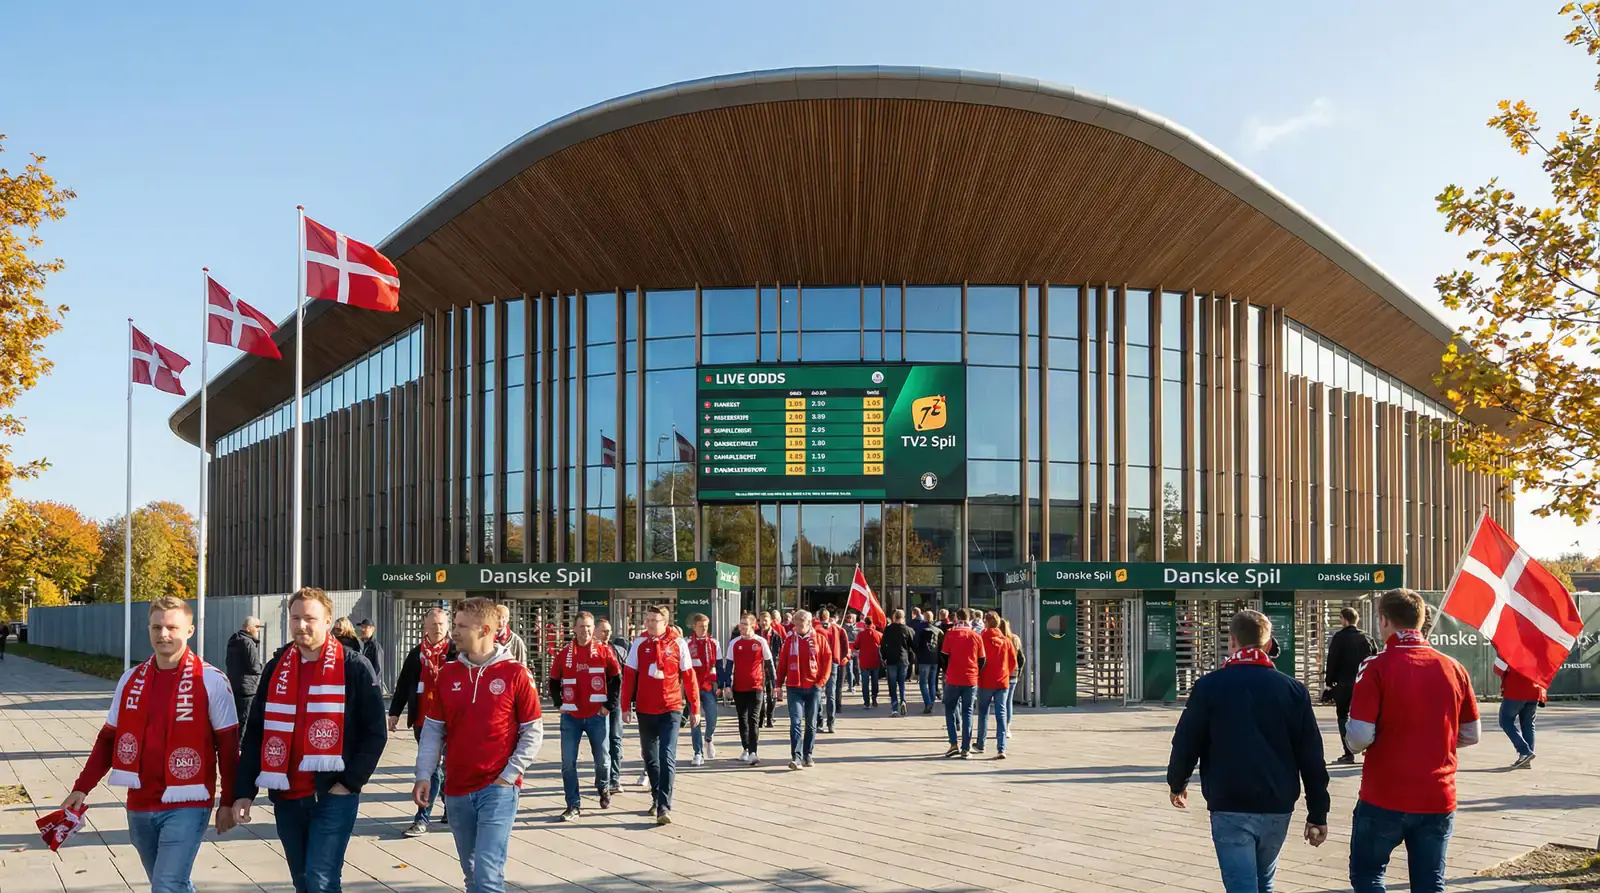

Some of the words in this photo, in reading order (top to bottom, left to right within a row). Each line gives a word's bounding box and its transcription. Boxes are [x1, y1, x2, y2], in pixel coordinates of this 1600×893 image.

[716, 373, 745, 384] LIVE
[748, 372, 786, 384] ODDS
[901, 436, 928, 447] TV2
[931, 435, 956, 450] Spil
[382, 573, 413, 581] Danske
[416, 573, 431, 582] Spil
[480, 568, 550, 584] Danske
[556, 568, 591, 586] Spil
[628, 571, 663, 580] Danske
[665, 571, 682, 582] Spil
[1056, 571, 1092, 580] Danske
[1094, 571, 1112, 582] Spil
[1164, 568, 1239, 584] Danske
[1245, 568, 1280, 587] Spil
[1318, 573, 1351, 581] Danske
[1353, 572, 1370, 583] Spil
[1430, 631, 1477, 646] anske
